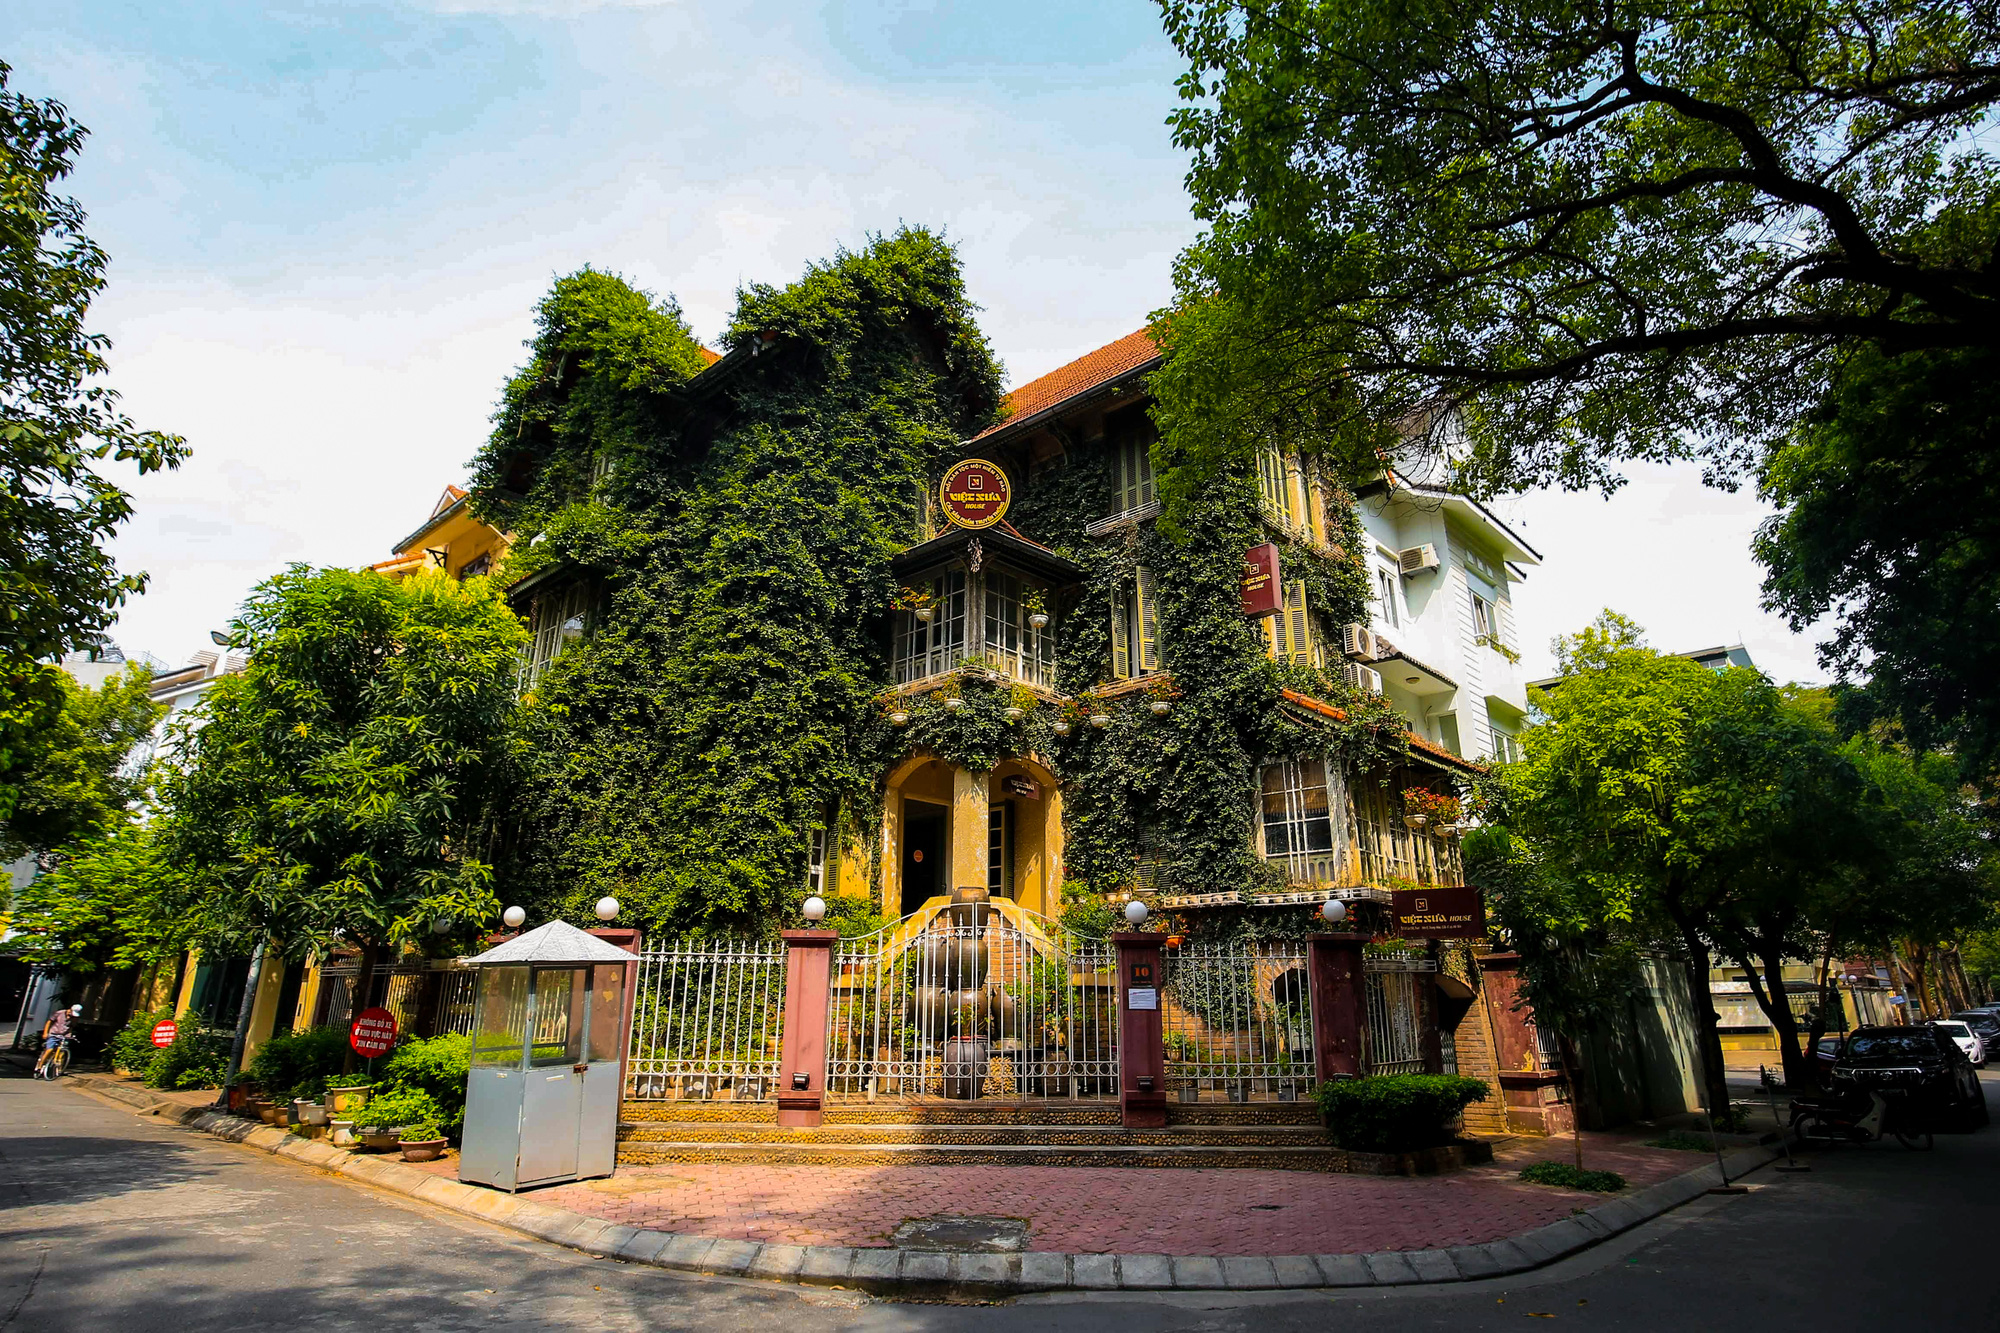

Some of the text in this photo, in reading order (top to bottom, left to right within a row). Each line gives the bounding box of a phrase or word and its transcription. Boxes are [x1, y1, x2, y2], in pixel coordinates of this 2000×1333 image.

[949, 491, 1001, 503] VIỆT XƯA
[1400, 913, 1472, 925] VIỆT XƯA HOUSE
[1135, 967, 1149, 977] 10
[359, 1018, 377, 1027] KHÔNG
[385, 1021, 392, 1029] XE
[359, 1029, 370, 1037] KHU
[381, 1030, 393, 1039] NÀY
